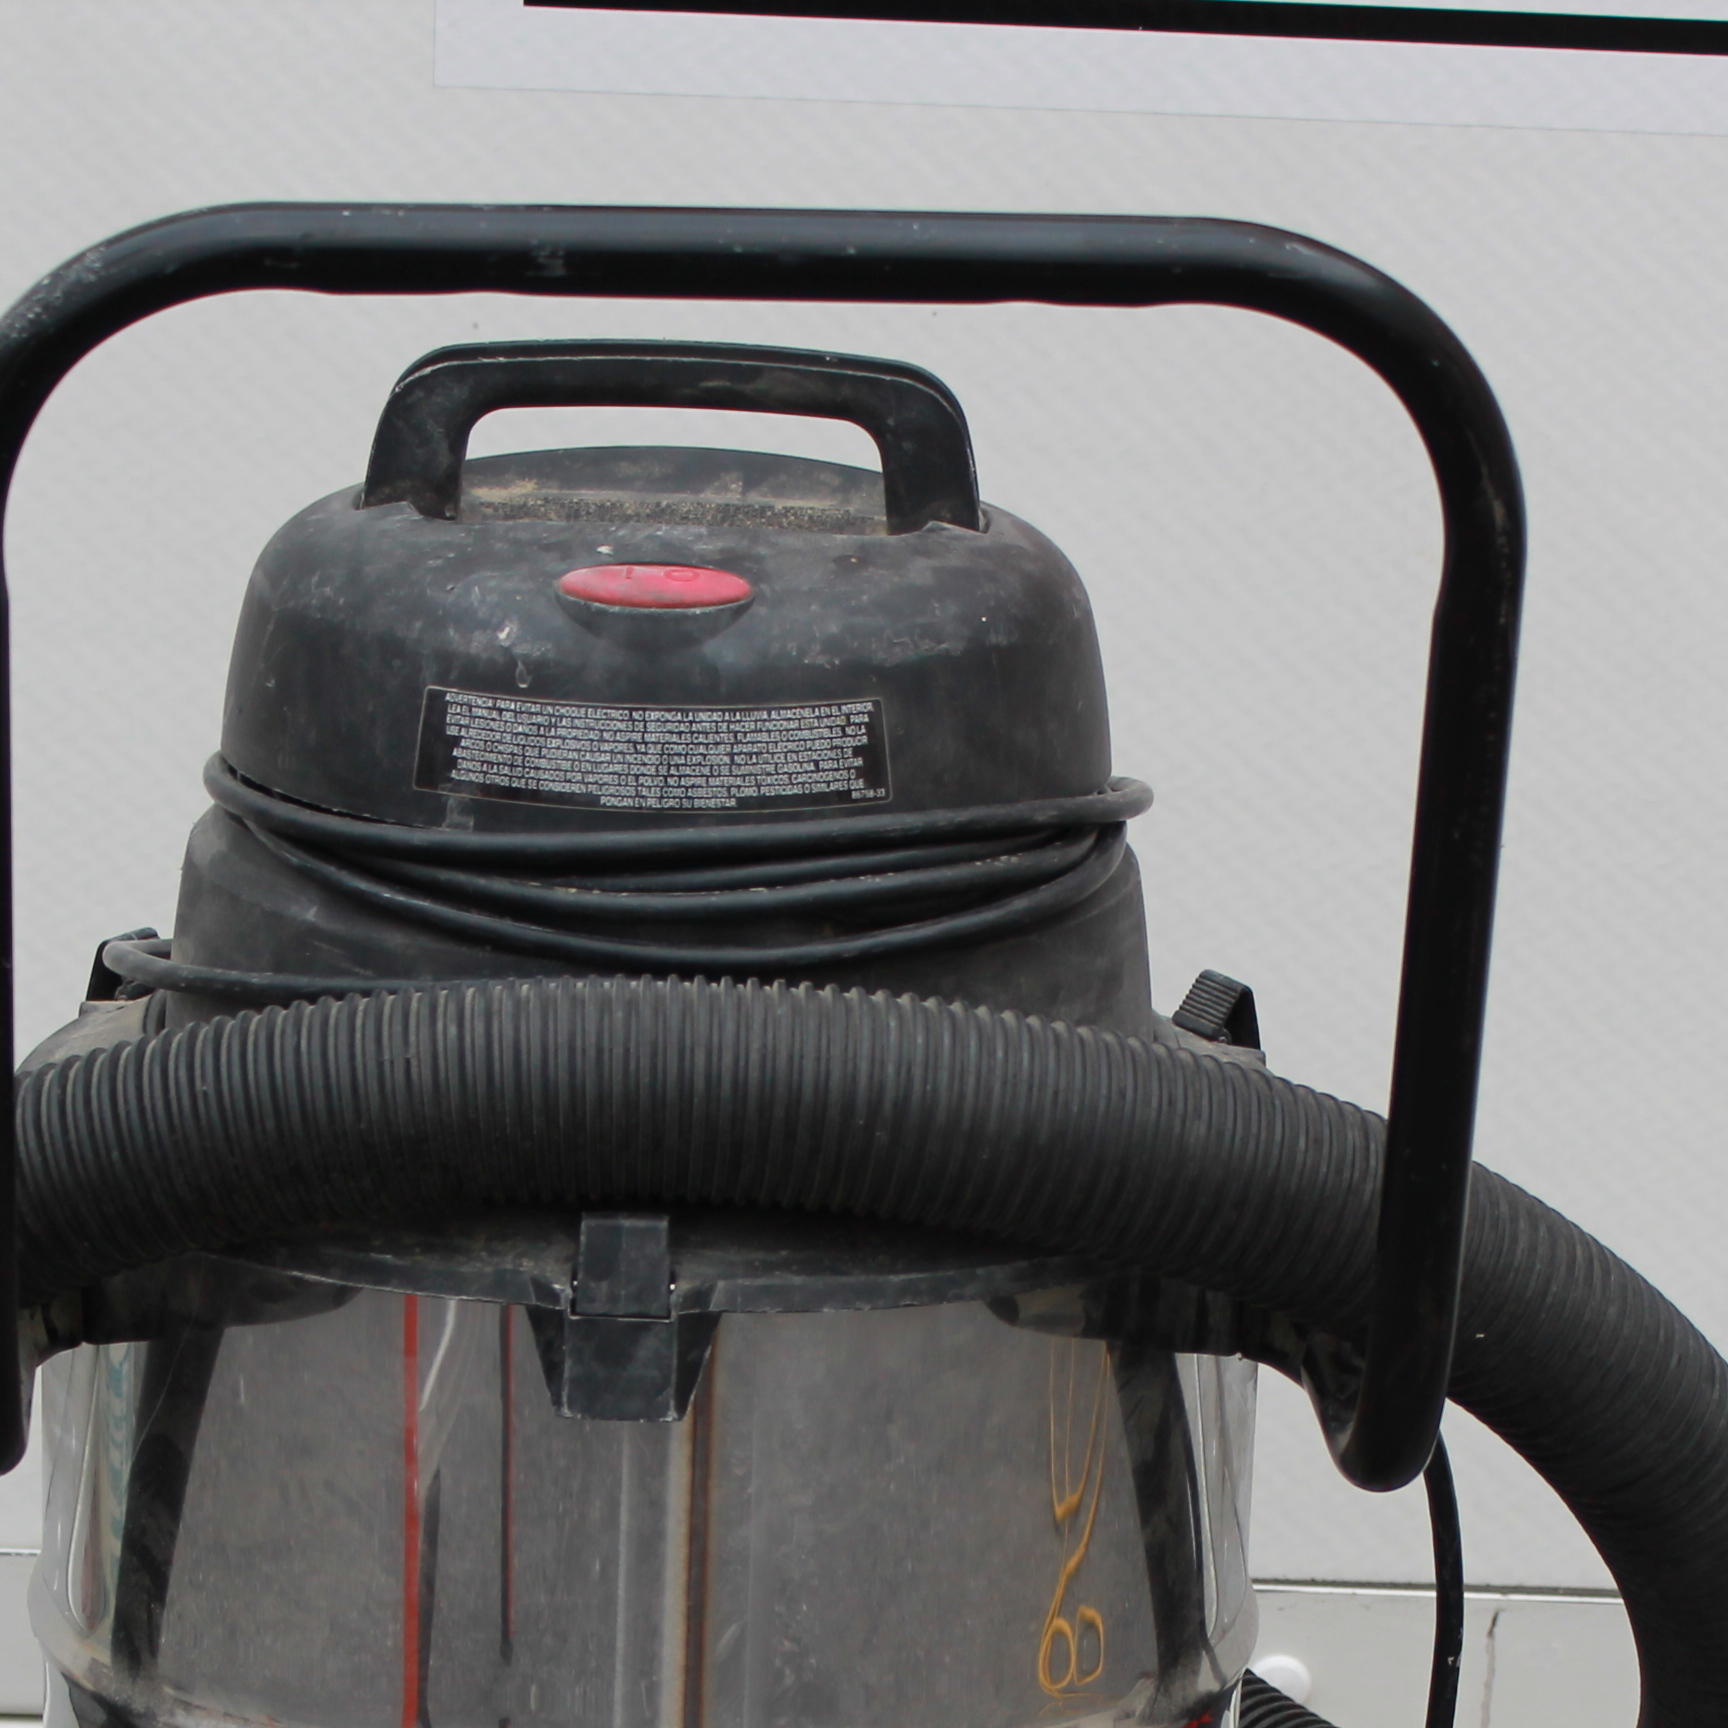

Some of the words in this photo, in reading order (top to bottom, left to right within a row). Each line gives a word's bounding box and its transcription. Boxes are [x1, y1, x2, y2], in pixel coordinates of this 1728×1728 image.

[683, 712, 693, 721] LA
[633, 722, 644, 731] DE
[717, 723, 727, 732] DE
[849, 713, 869, 724] PARA
[842, 748, 852, 757] DE
